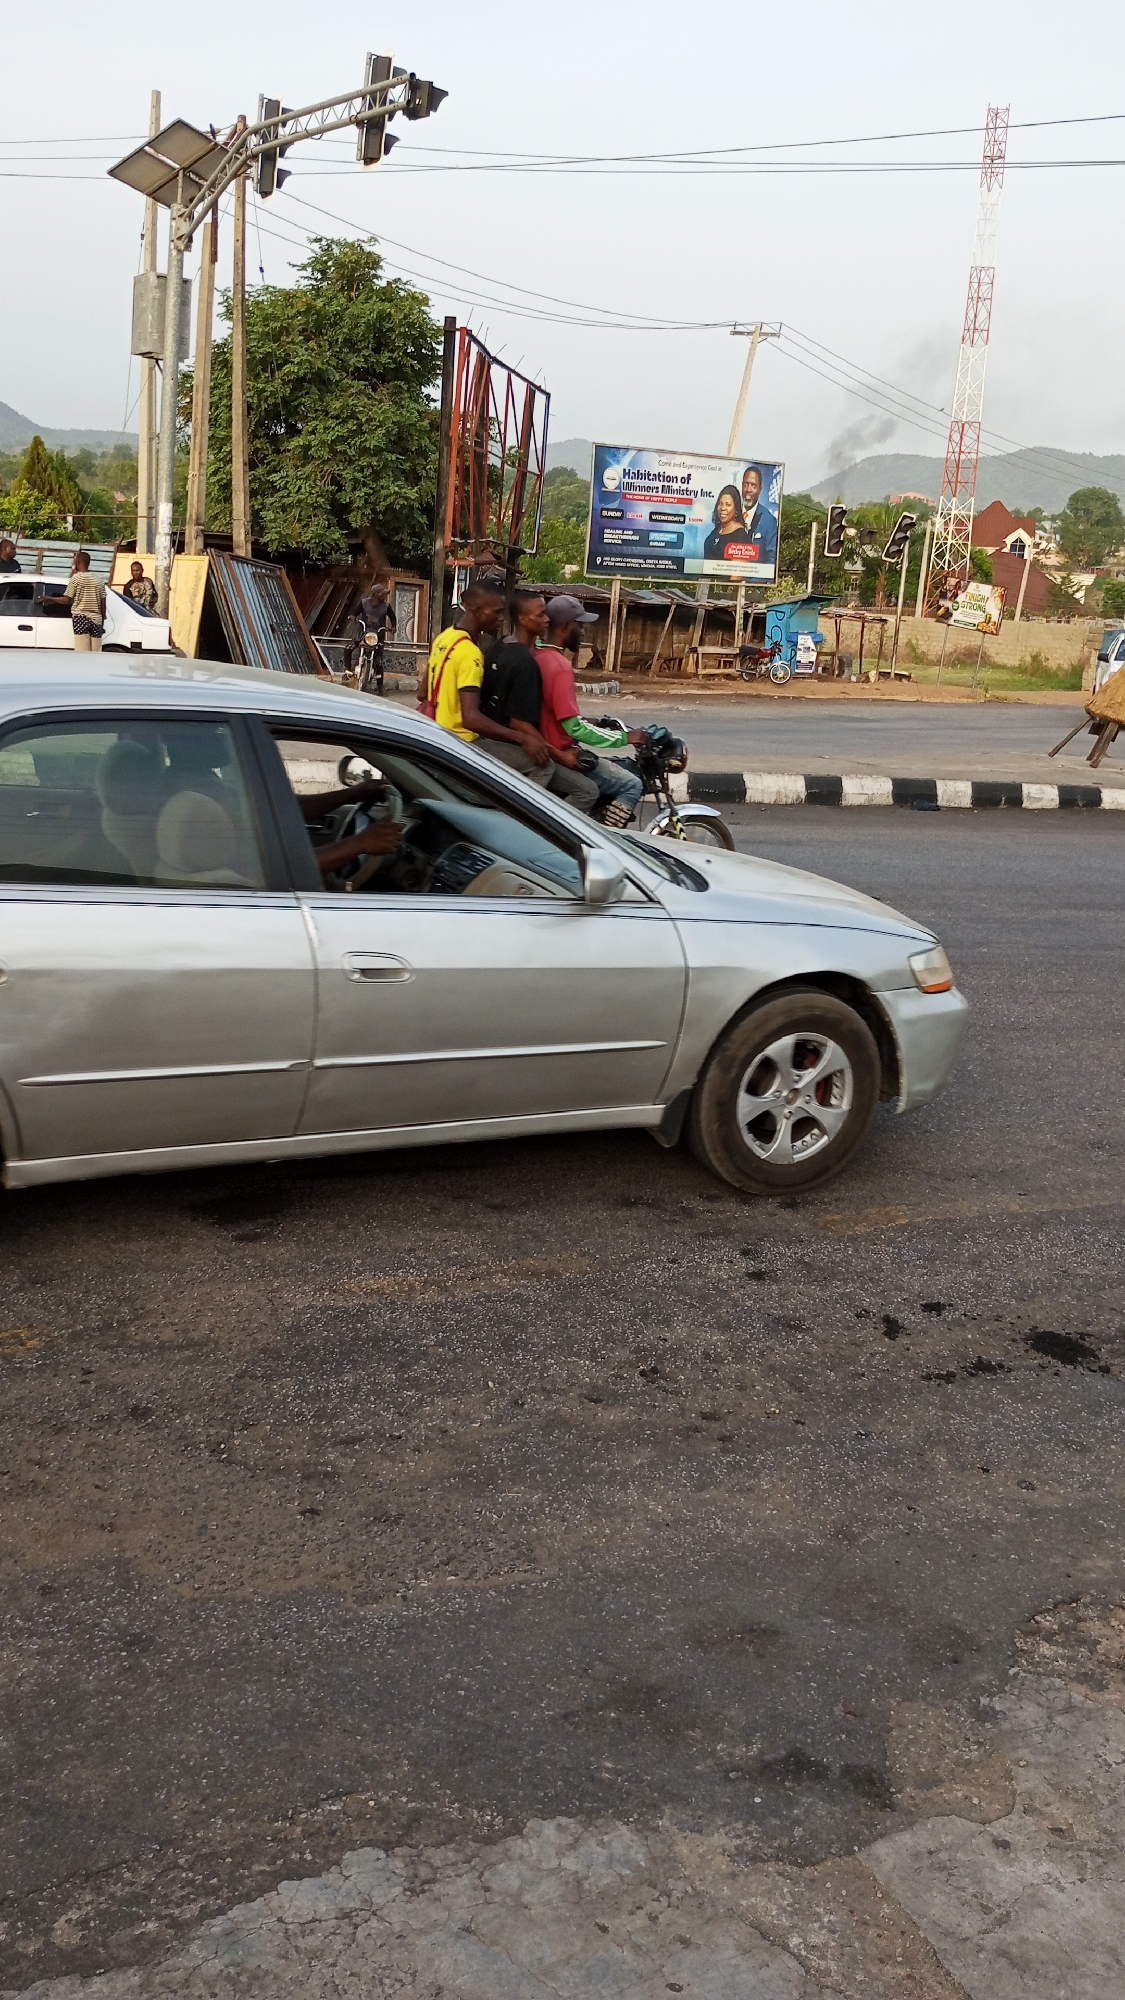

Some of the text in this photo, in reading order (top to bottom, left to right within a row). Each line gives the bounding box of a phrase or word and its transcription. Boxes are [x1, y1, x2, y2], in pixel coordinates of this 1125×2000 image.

[658, 460, 671, 468] Come
[682, 462, 707, 471] Experience
[622, 468, 692, 485] Habitation of
[622, 481, 715, 498] Winners Ministry Inc.
[961, 600, 986, 613] STRONG
